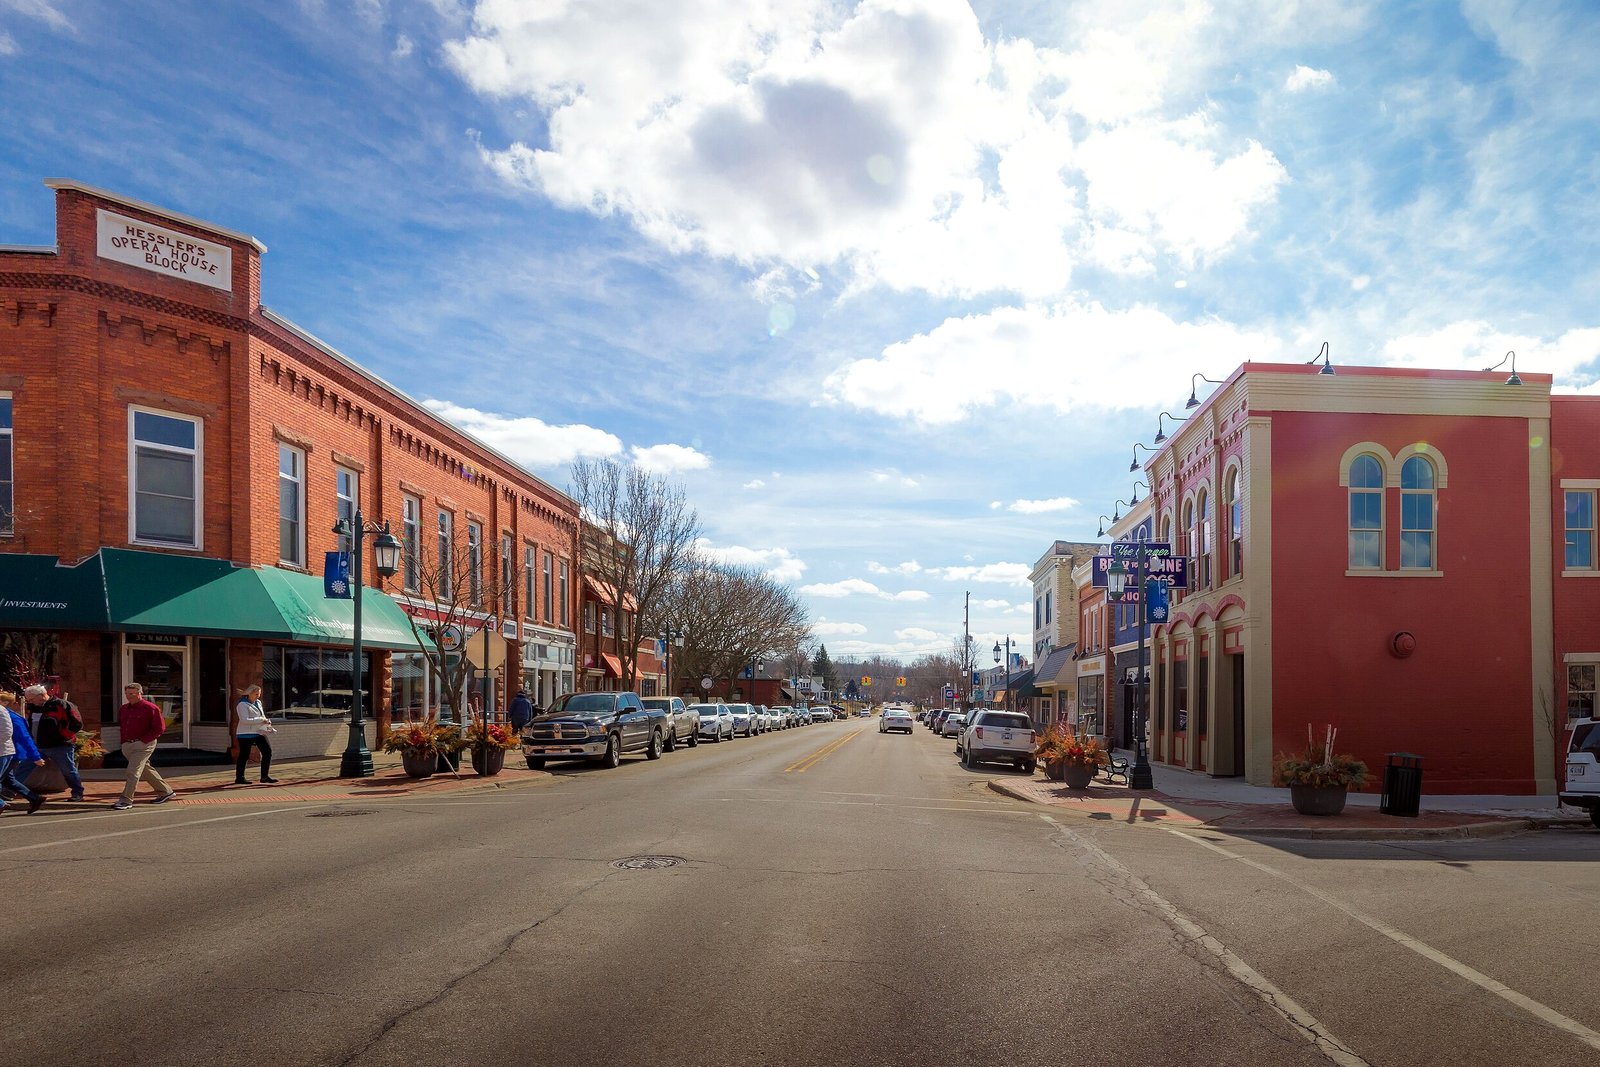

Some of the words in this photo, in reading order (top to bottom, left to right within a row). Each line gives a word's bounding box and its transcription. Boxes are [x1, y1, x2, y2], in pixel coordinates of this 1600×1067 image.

[126, 225, 206, 257] HESSLER'S
[111, 236, 161, 255] OPERA
[171, 248, 219, 275] HOUSE
[145, 253, 187, 274] BLOCK
[1135, 545, 1169, 557] Crner
[1099, 558, 1130, 572] BER
[1144, 574, 1176, 586] OGS
[1108, 591, 1147, 602] LQUO
[4, 600, 68, 610] INVESTMENTS
[155, 635, 178, 643] MAIN
